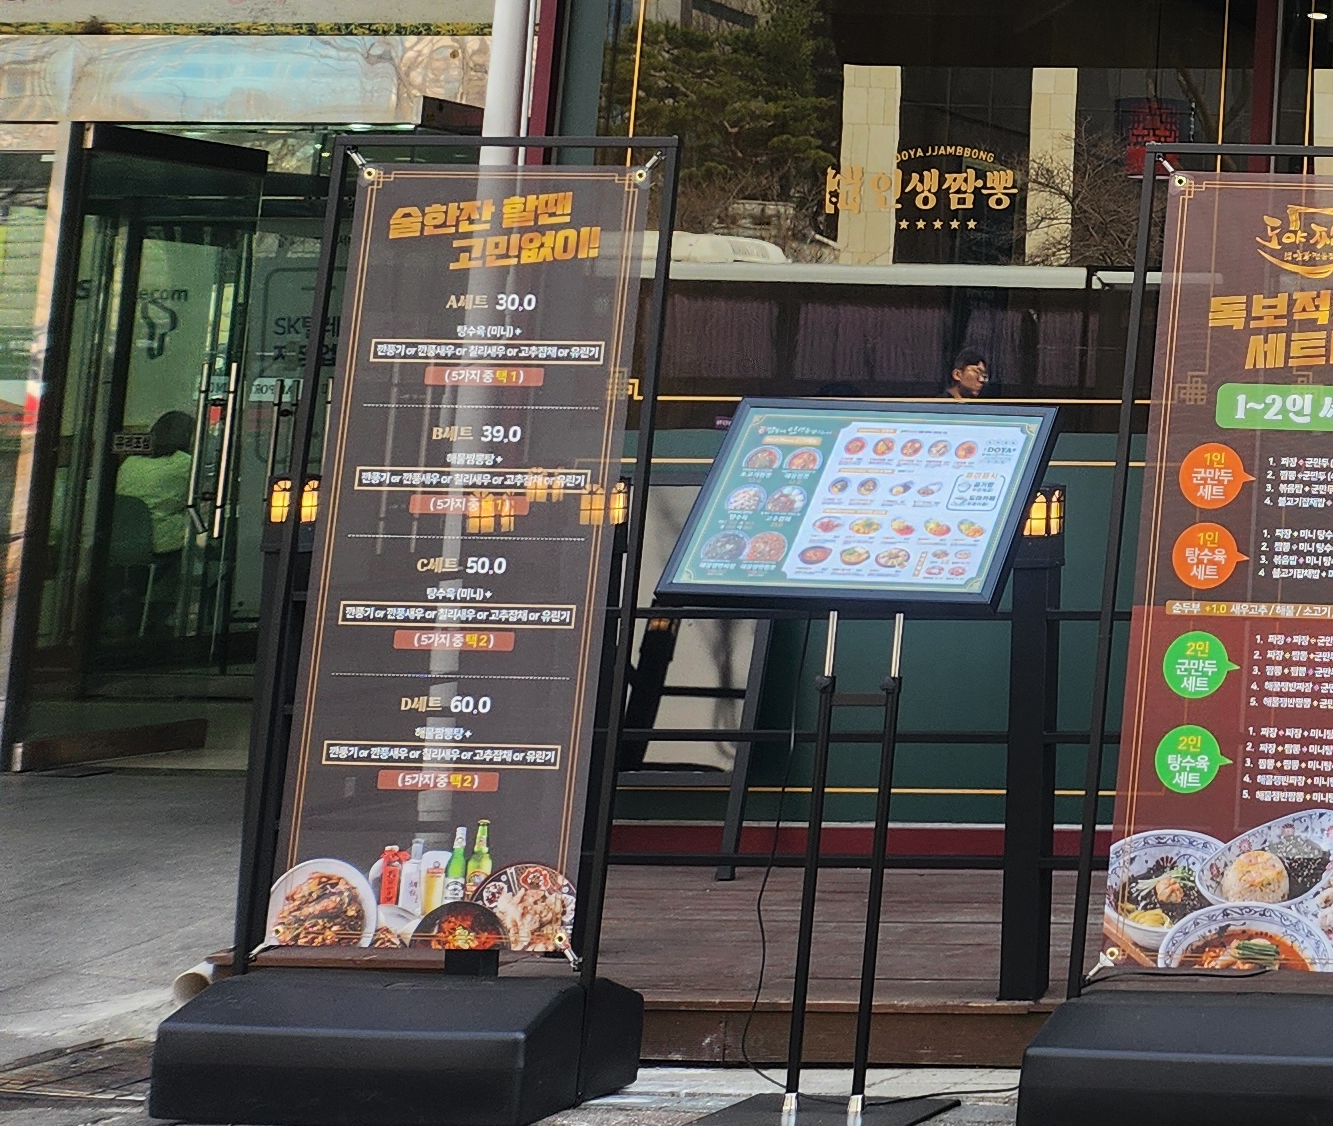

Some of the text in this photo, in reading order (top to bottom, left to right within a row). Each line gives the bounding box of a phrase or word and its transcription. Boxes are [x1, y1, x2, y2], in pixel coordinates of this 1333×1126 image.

[925, 145, 996, 163] JJAMBBONG
[870, 168, 1019, 210] 인생짬뽕
[388, 191, 574, 240] 술한잔 할땐
[446, 294, 537, 312] A세트 30.0
[1234, 394, 1313, 423] 1~2인
[431, 425, 522, 444] B세트 39.0
[1203, 452, 1226, 467] 1인
[1191, 468, 1234, 485] 군만두
[1197, 485, 1226, 501] 세트
[1197, 532, 1219, 547] 1인
[1185, 548, 1227, 564] 탕수육
[416, 557, 507, 575] C세트 50.0
[1190, 565, 1219, 580] 세트
[1172, 603, 1201, 615] 순두부
[1186, 641, 1210, 657] 2인
[1175, 659, 1218, 675] 군만두
[1181, 676, 1209, 692] 세트
[400, 696, 492, 714] D세트 60.0
[1177, 735, 1202, 751] 2인
[1167, 755, 1210, 771] 탕수육
[1172, 772, 1202, 788] 세트
